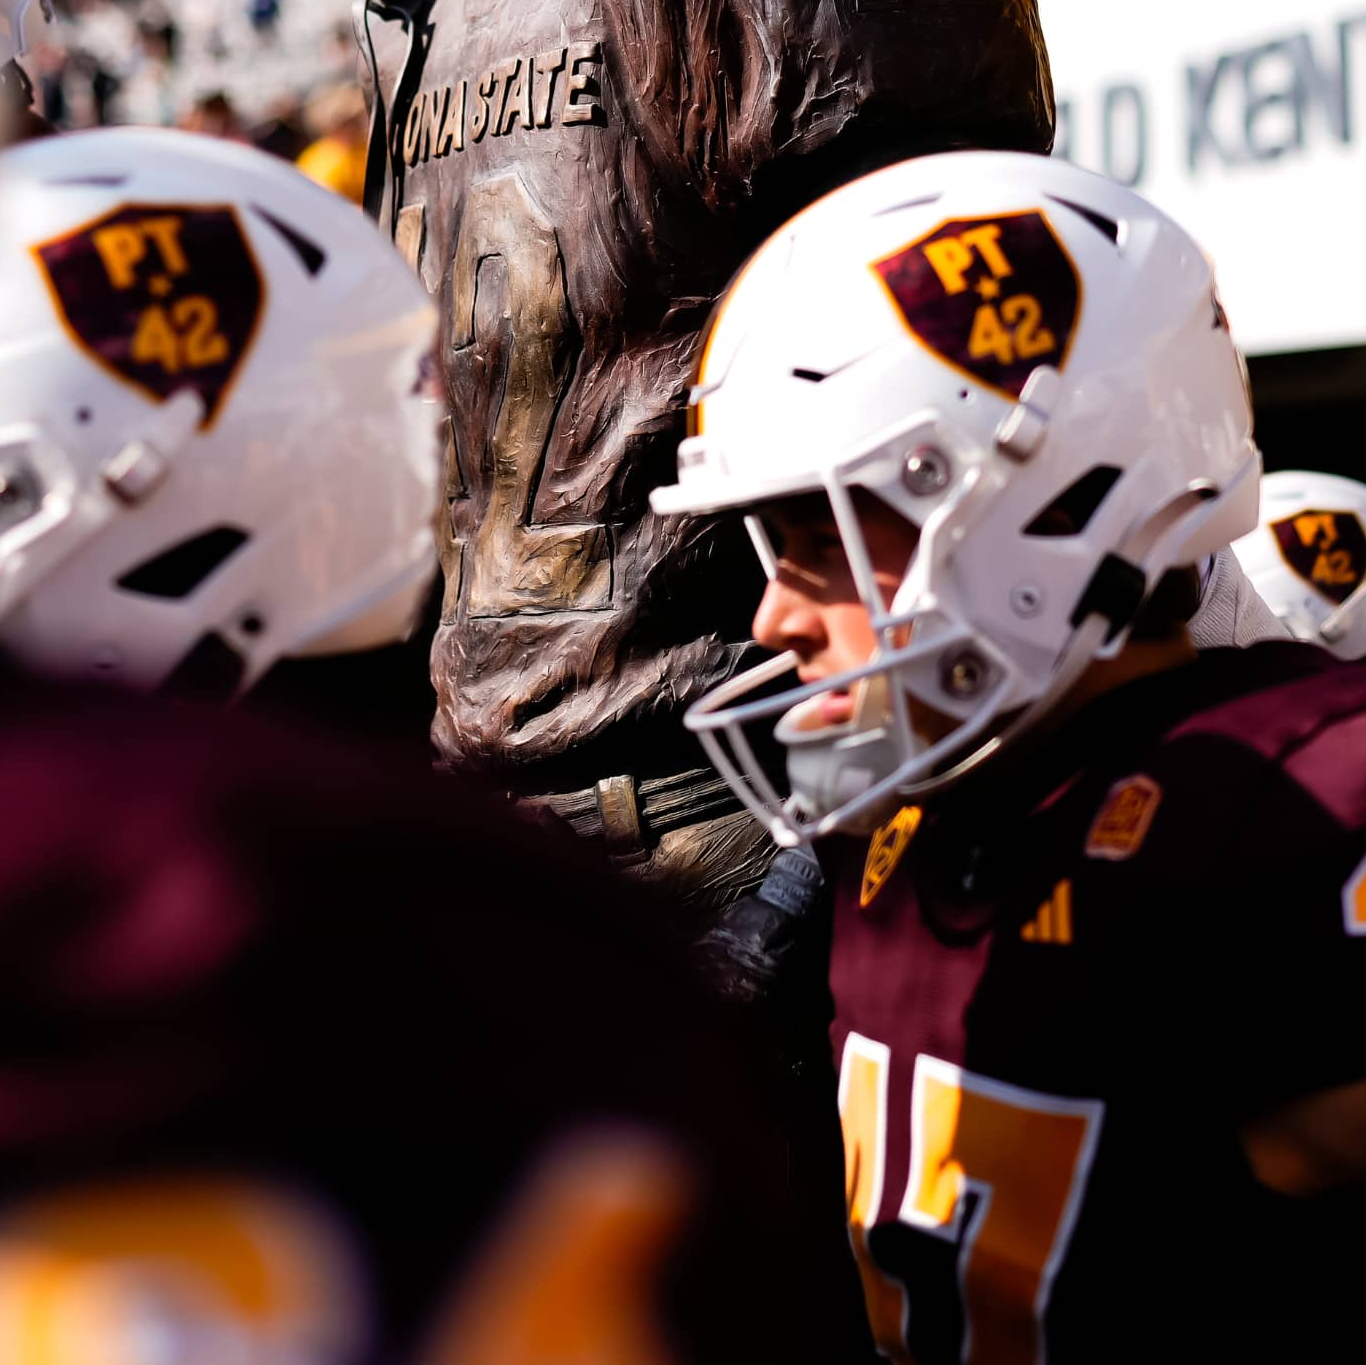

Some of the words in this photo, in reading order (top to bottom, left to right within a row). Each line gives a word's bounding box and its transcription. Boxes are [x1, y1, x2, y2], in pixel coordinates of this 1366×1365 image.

[471, 40, 607, 143] STATE
[92, 214, 189, 291] PT
[923, 223, 1013, 296] PT
[131, 295, 229, 373] 42
[967, 293, 1056, 366] 42
